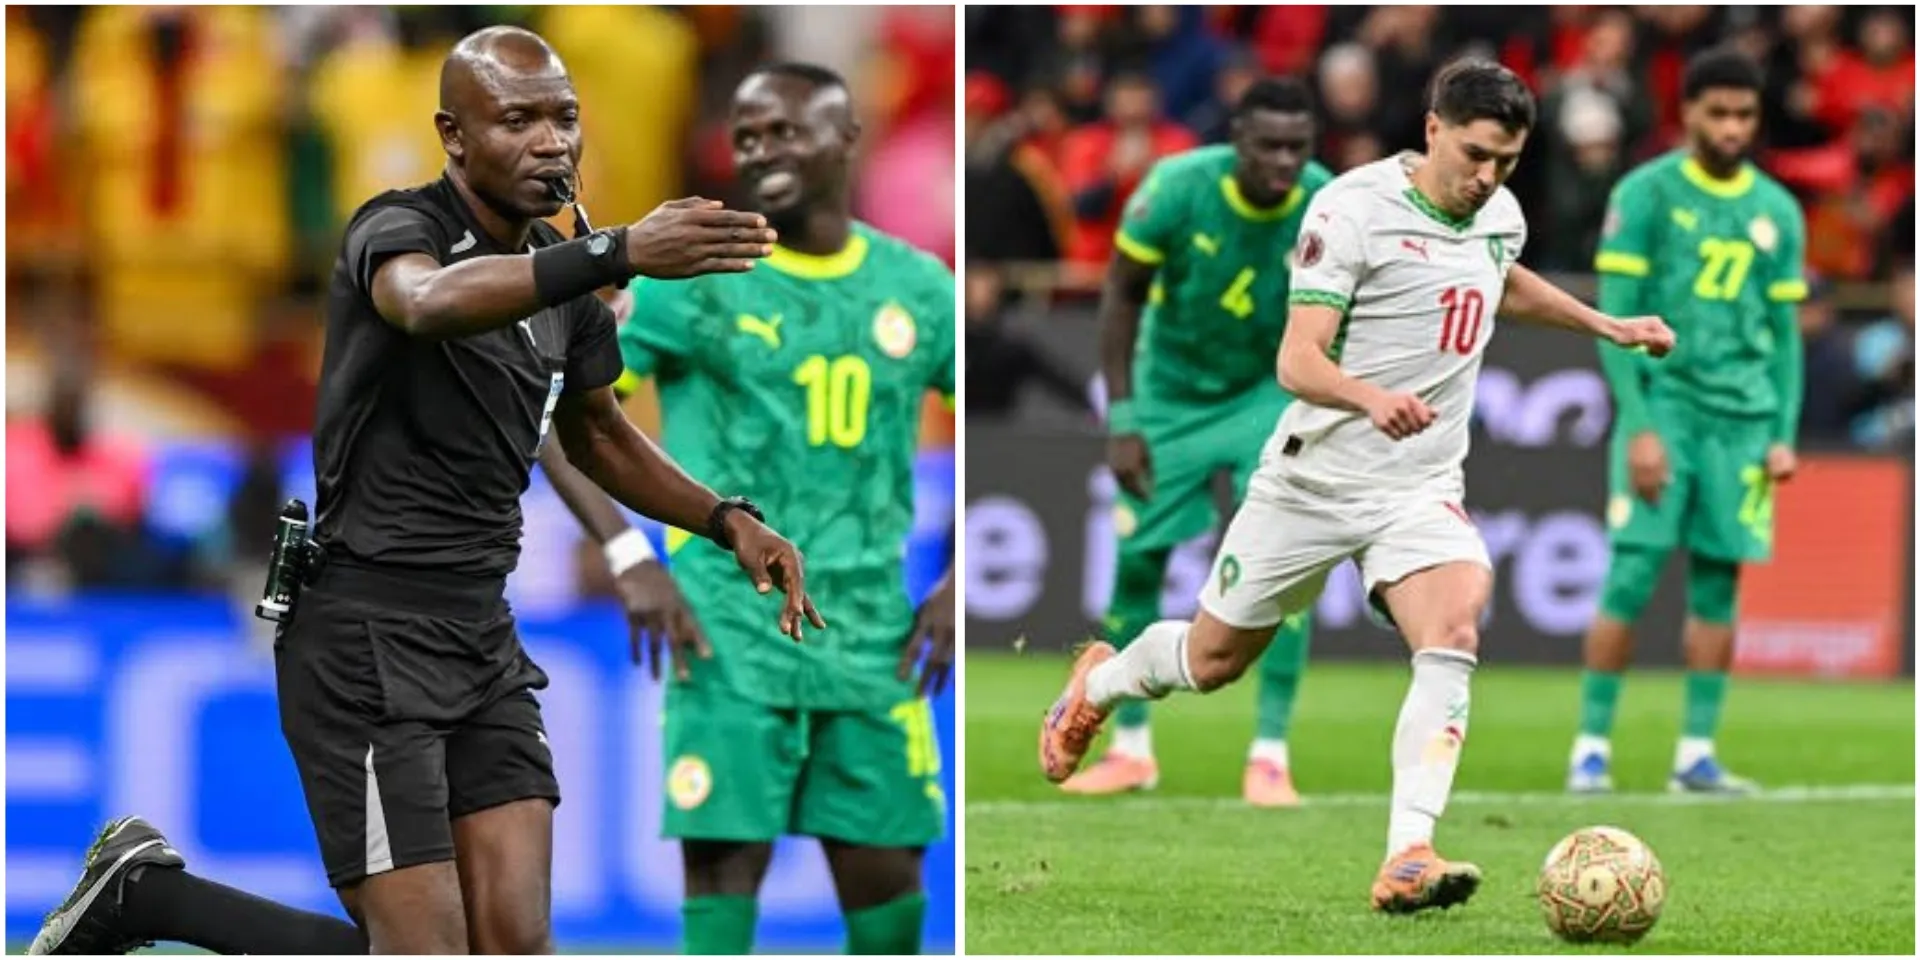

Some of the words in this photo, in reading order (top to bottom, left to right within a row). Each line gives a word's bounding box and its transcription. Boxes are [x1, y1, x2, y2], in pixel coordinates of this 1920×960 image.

[1694, 237, 1754, 300] 27
[1437, 286, 1484, 355] 10
[793, 354, 871, 447] 10
